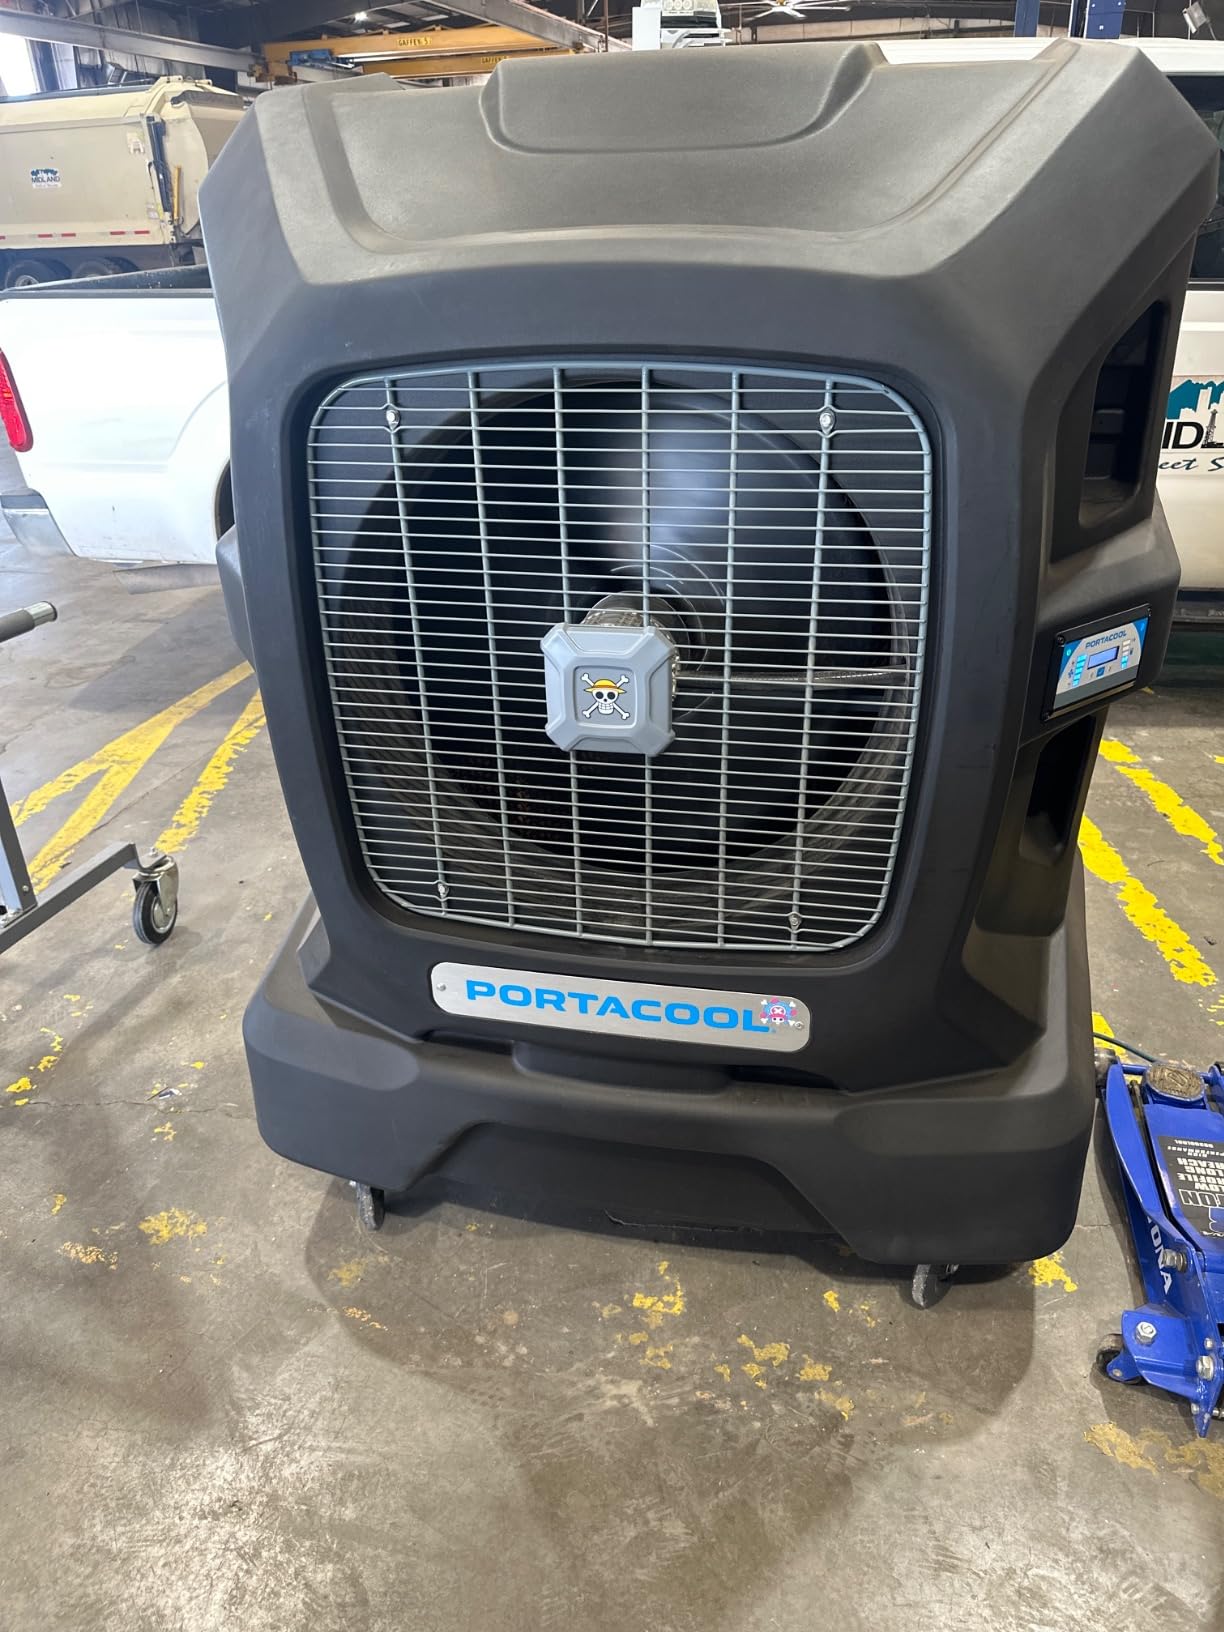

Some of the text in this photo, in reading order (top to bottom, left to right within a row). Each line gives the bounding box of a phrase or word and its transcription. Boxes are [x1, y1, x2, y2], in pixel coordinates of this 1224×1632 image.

[1085, 629, 1128, 649] PORTACOOL
[466, 979, 770, 1033] PORTACOOL
[1183, 1165, 1224, 1177] LONG
[1147, 1216, 1173, 1295] ONA
